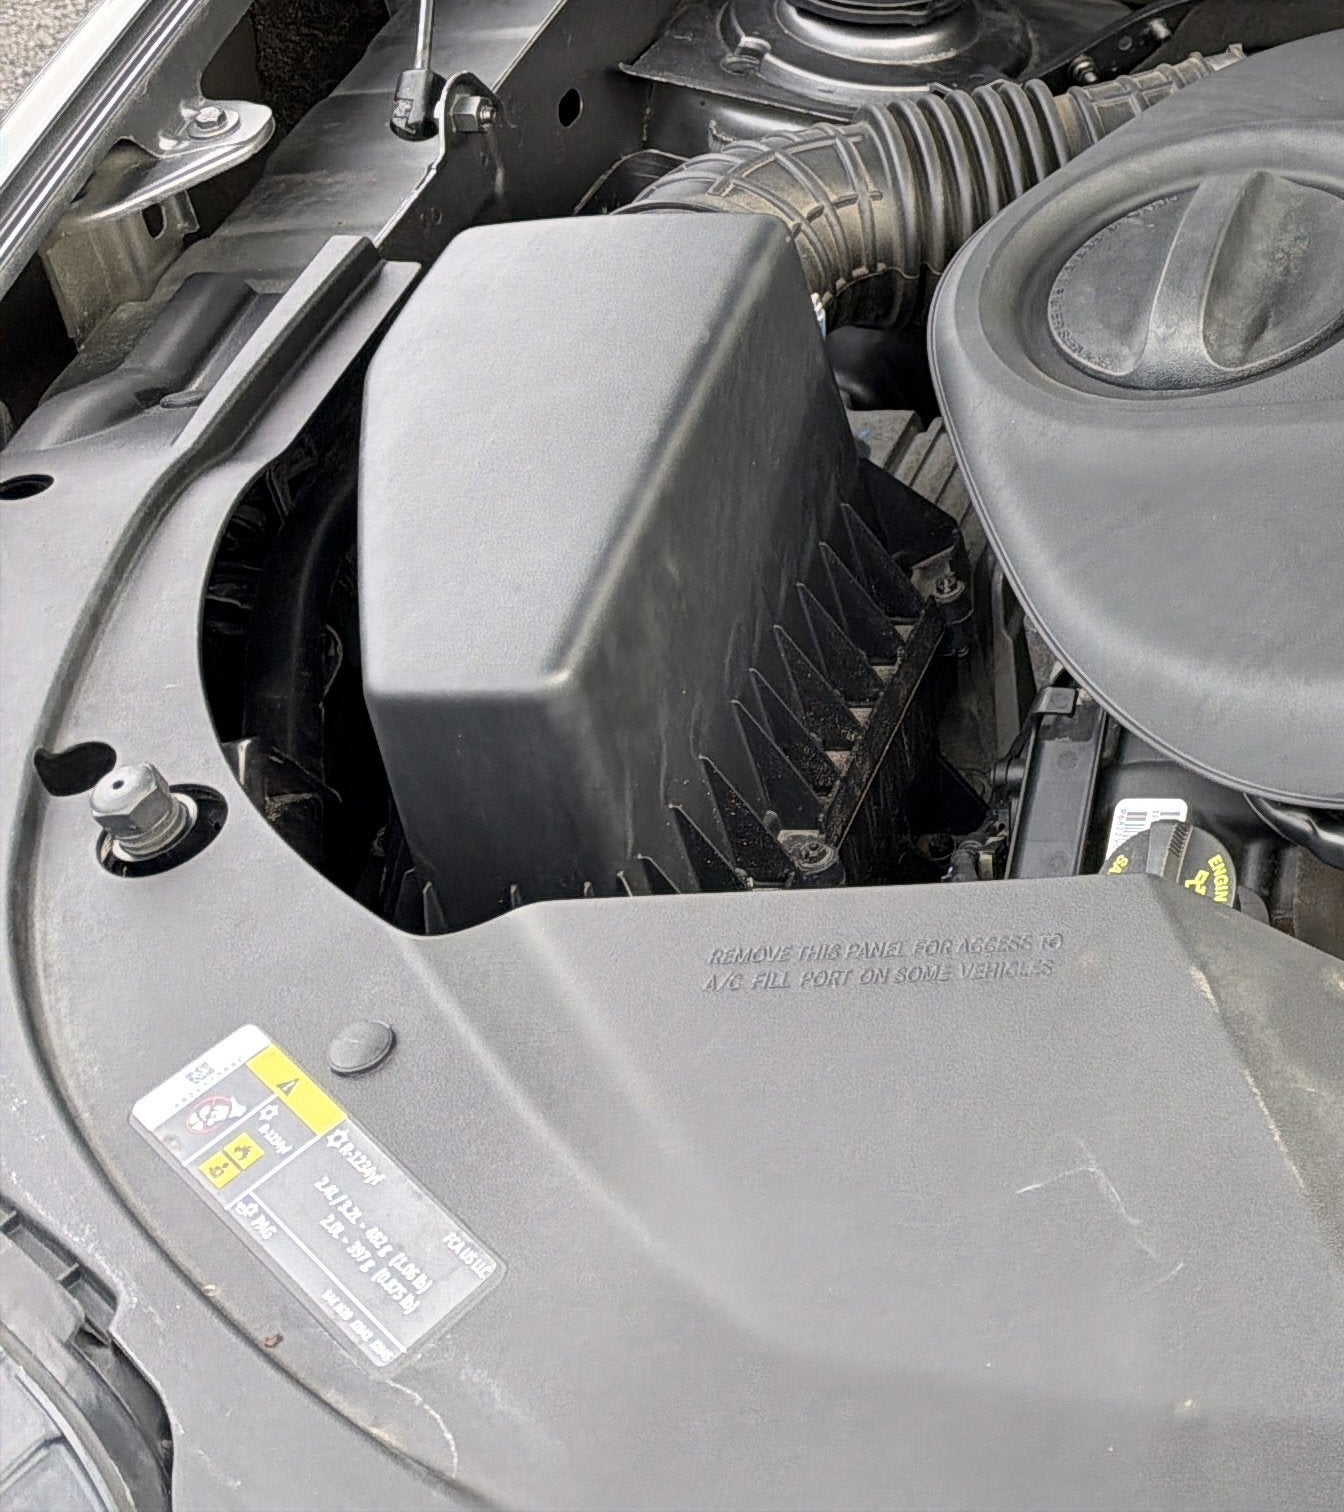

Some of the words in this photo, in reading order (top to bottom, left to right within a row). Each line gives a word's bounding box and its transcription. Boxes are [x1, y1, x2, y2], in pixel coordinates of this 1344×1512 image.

[1207, 853, 1229, 903] ENGIN
[708, 945, 793, 965] REMOVE
[799, 942, 842, 962] THIS
[845, 940, 904, 961] PANEL
[913, 938, 952, 957] FOR
[956, 934, 1033, 954] ACCESS
[702, 972, 744, 992] A/C
[751, 970, 791, 990] FILL
[800, 969, 854, 989] PORT
[859, 967, 889, 986] ON
[893, 963, 951, 984] SOME
[959, 959, 1055, 980] VEHICLES
[339, 1143, 386, 1186] R-1234yf
[251, 1214, 277, 1240] PAG
[347, 1240, 372, 1262] 397
[442, 1232, 462, 1255] FCA
[459, 1247, 478, 1266] US
[470, 1259, 493, 1280] LLC
